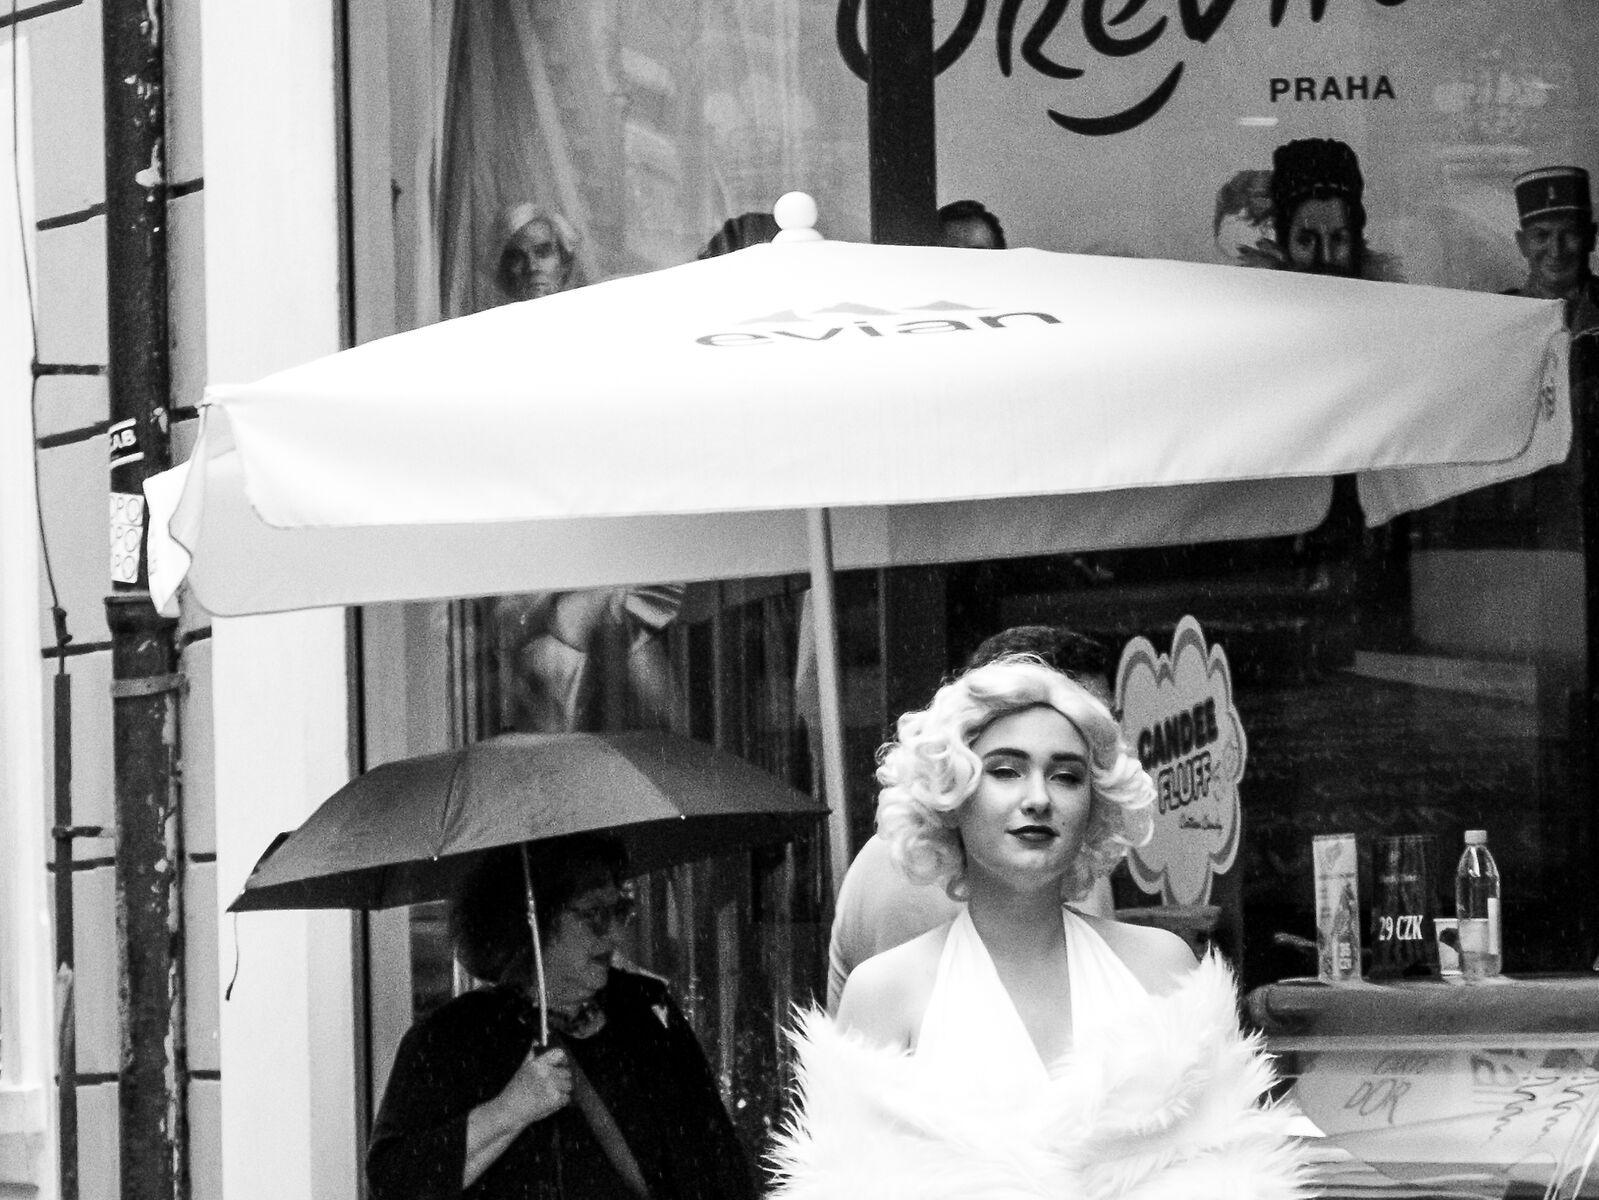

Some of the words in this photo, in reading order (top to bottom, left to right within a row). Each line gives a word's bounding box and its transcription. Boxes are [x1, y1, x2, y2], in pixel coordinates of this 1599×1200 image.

[1269, 75, 1396, 102] PRAHA
[695, 310, 1063, 347] evian
[1138, 696, 1219, 772] CANDEE
[1157, 750, 1212, 815] FLUFF
[1377, 915, 1394, 941] 29
[1396, 915, 1424, 940] CZK
